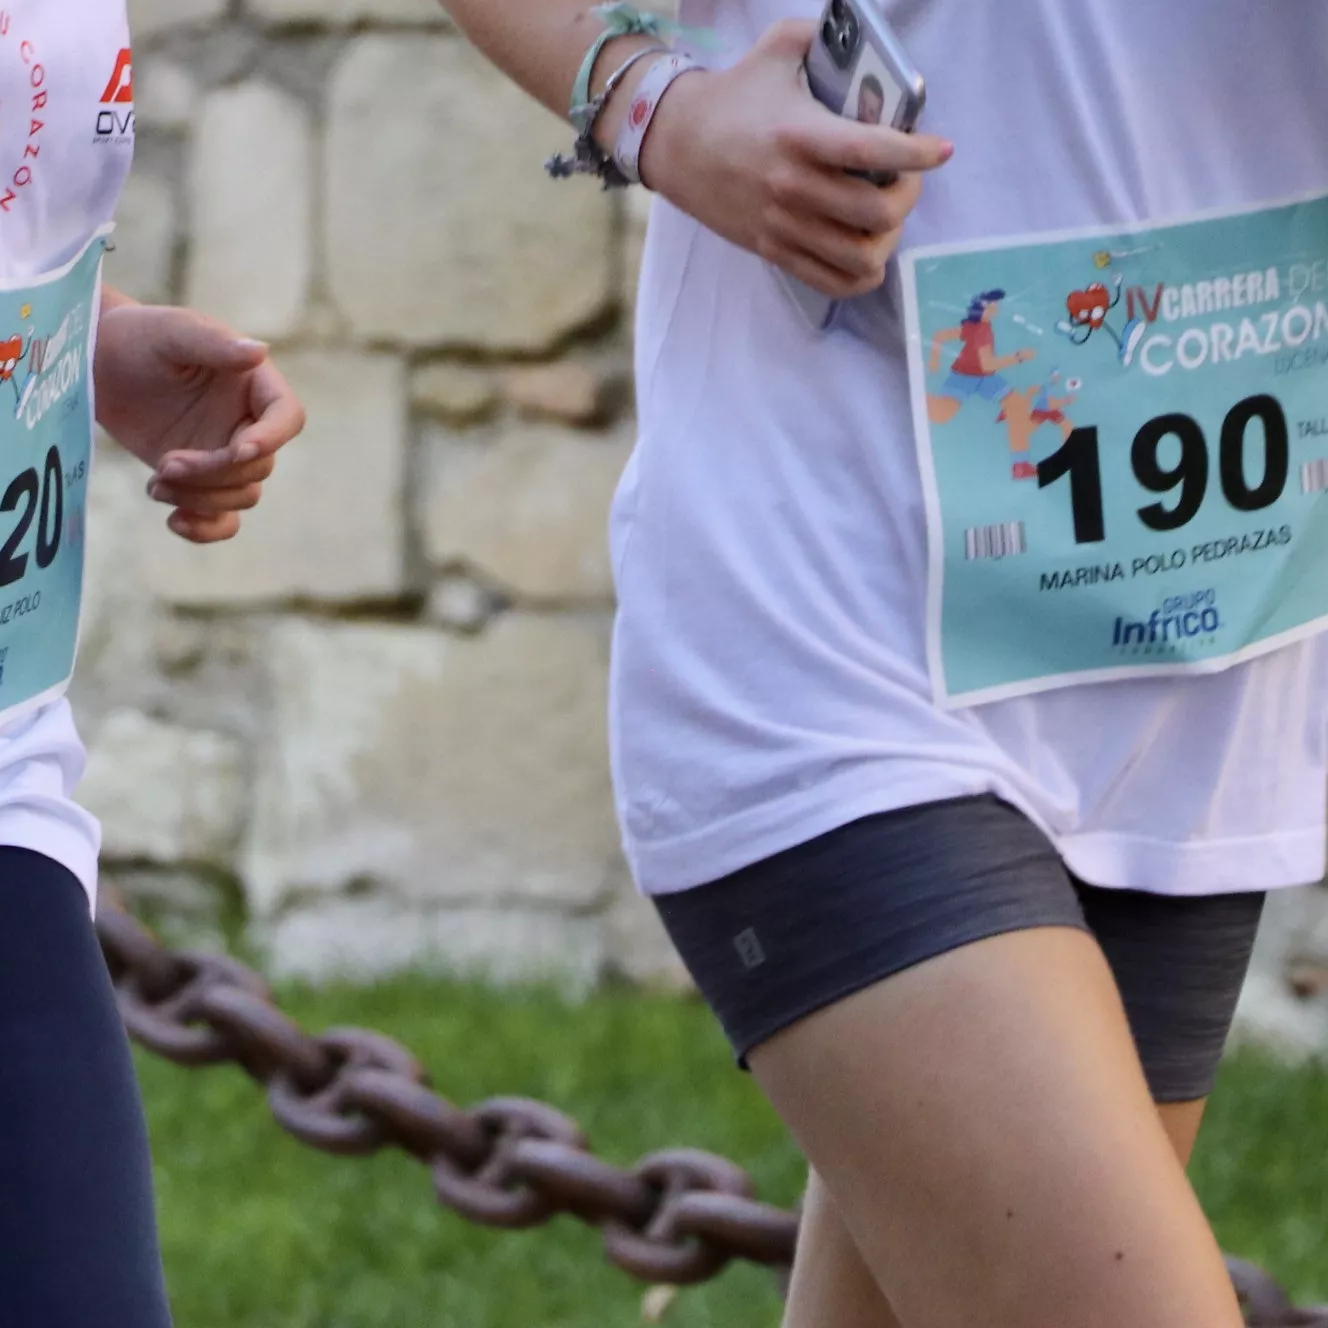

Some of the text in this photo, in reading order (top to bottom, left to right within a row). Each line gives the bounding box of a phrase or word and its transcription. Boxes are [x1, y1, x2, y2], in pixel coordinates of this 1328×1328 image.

[1125, 282, 1165, 324] IV
[1162, 265, 1280, 322] CARRERA
[1038, 393, 1289, 545] 190
[1039, 524, 1292, 592] MARINA POLO PEDRAZAS
[13, 590, 41, 619] POLO
[1112, 607, 1220, 646] Infrico
